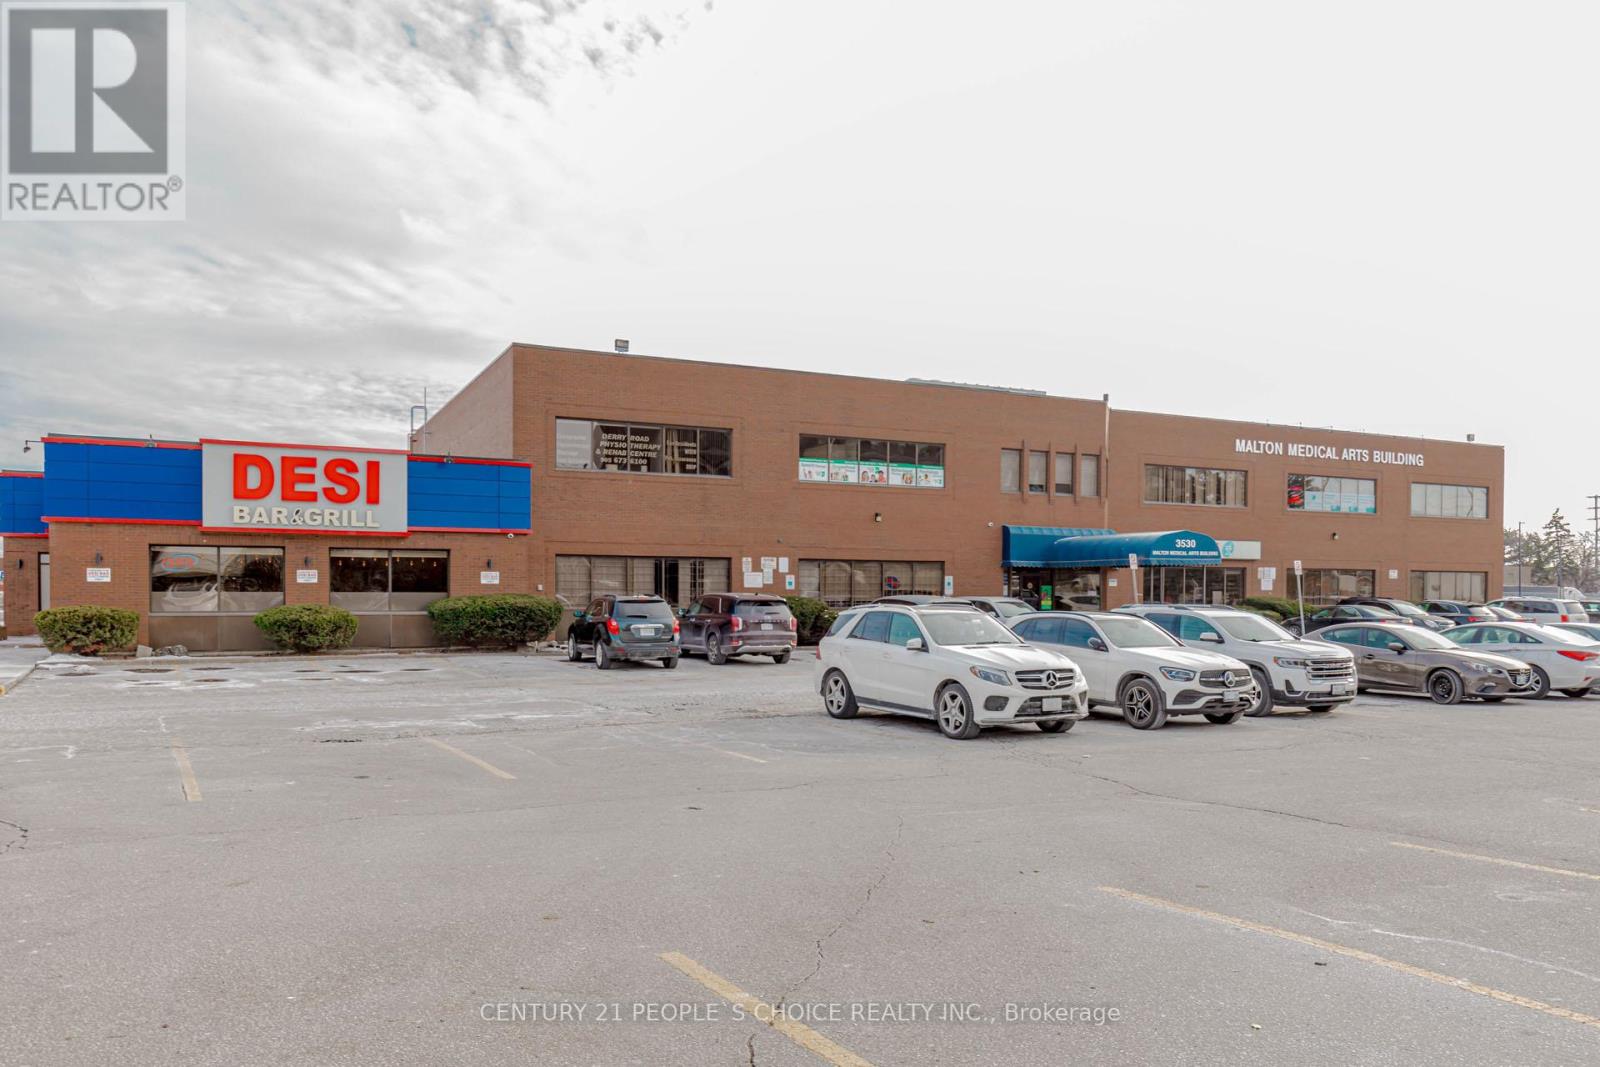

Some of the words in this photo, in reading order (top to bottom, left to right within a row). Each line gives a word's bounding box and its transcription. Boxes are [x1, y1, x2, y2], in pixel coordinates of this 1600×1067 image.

[602, 433, 627, 441] DERRY
[599, 441, 627, 449] PHYSIO
[630, 443, 661, 451] THERAPY
[1235, 439, 1283, 455] MALTON
[1287, 443, 1339, 460] MEDICAL
[1341, 448, 1370, 462] ARTS
[1373, 451, 1424, 467] BUILDING
[233, 453, 380, 505] DESI
[1175, 539, 1196, 548] 3530
